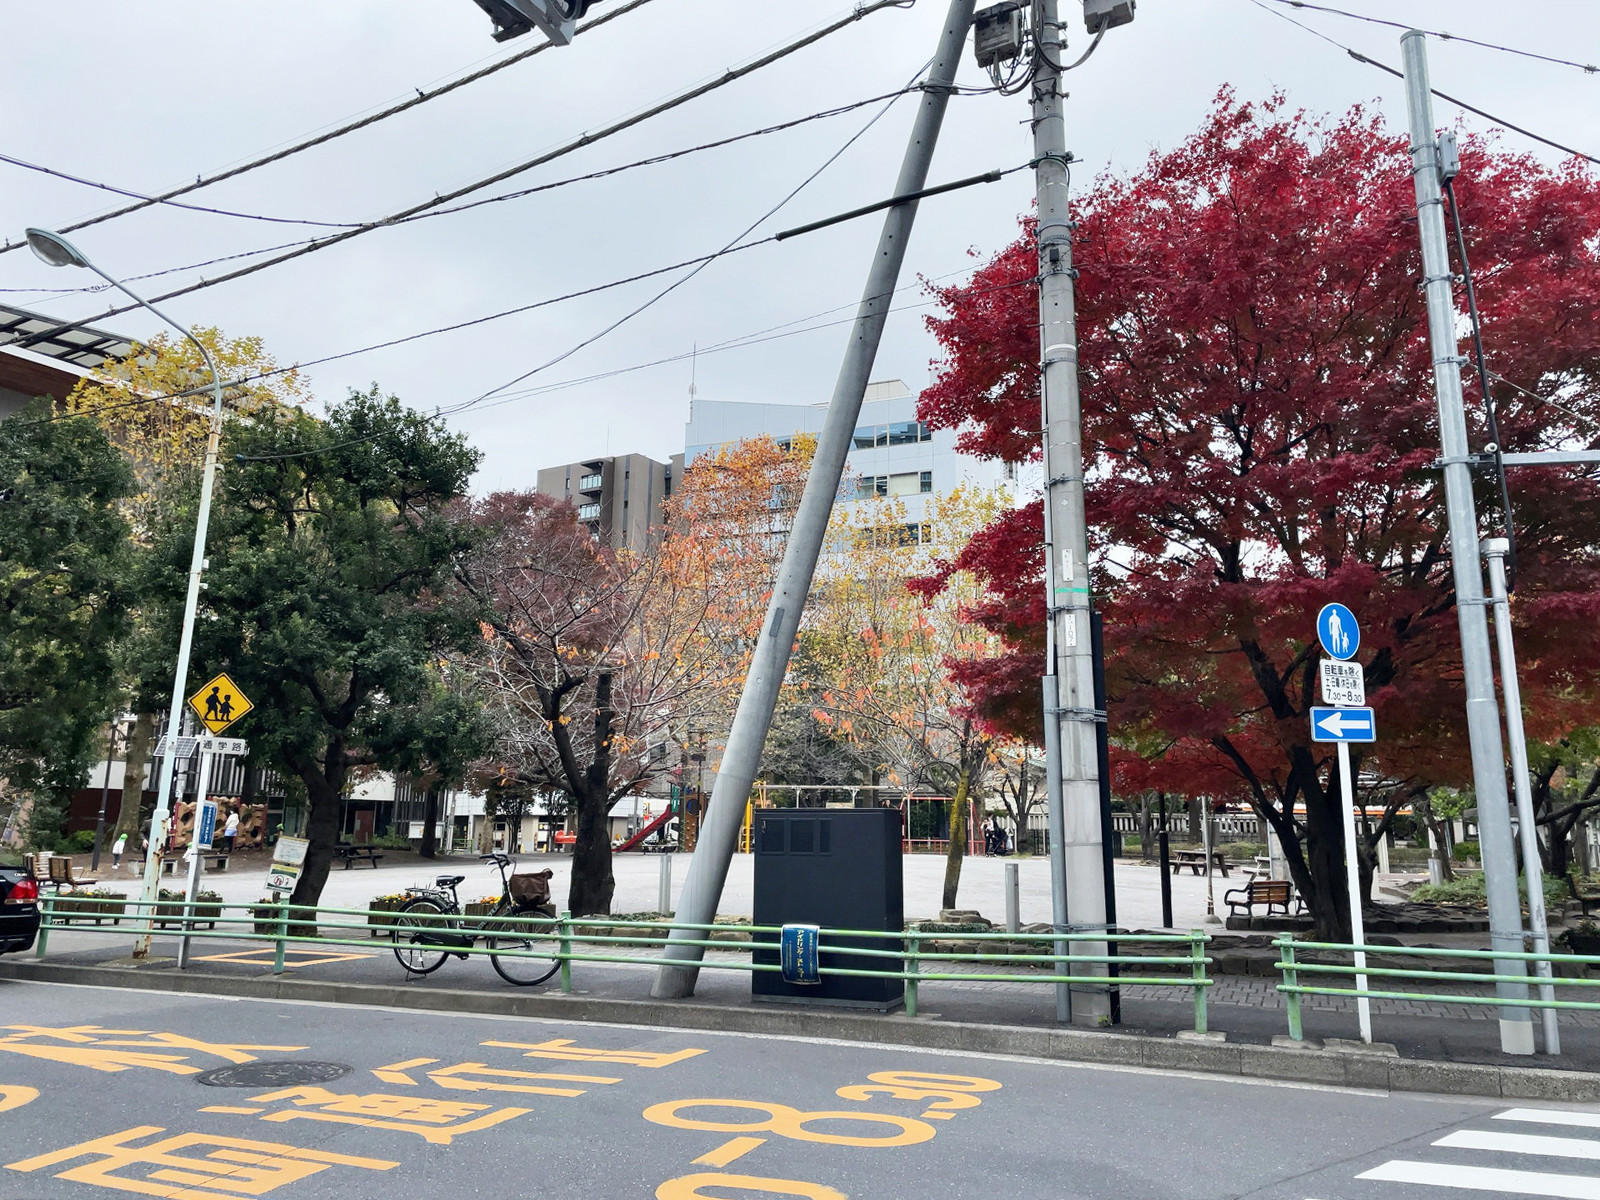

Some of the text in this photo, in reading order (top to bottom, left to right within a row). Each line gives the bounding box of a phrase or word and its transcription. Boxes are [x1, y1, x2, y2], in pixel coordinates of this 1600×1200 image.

[1324, 664, 1360, 677] 自転車を除く
[202, 739, 242, 752] 通学路
